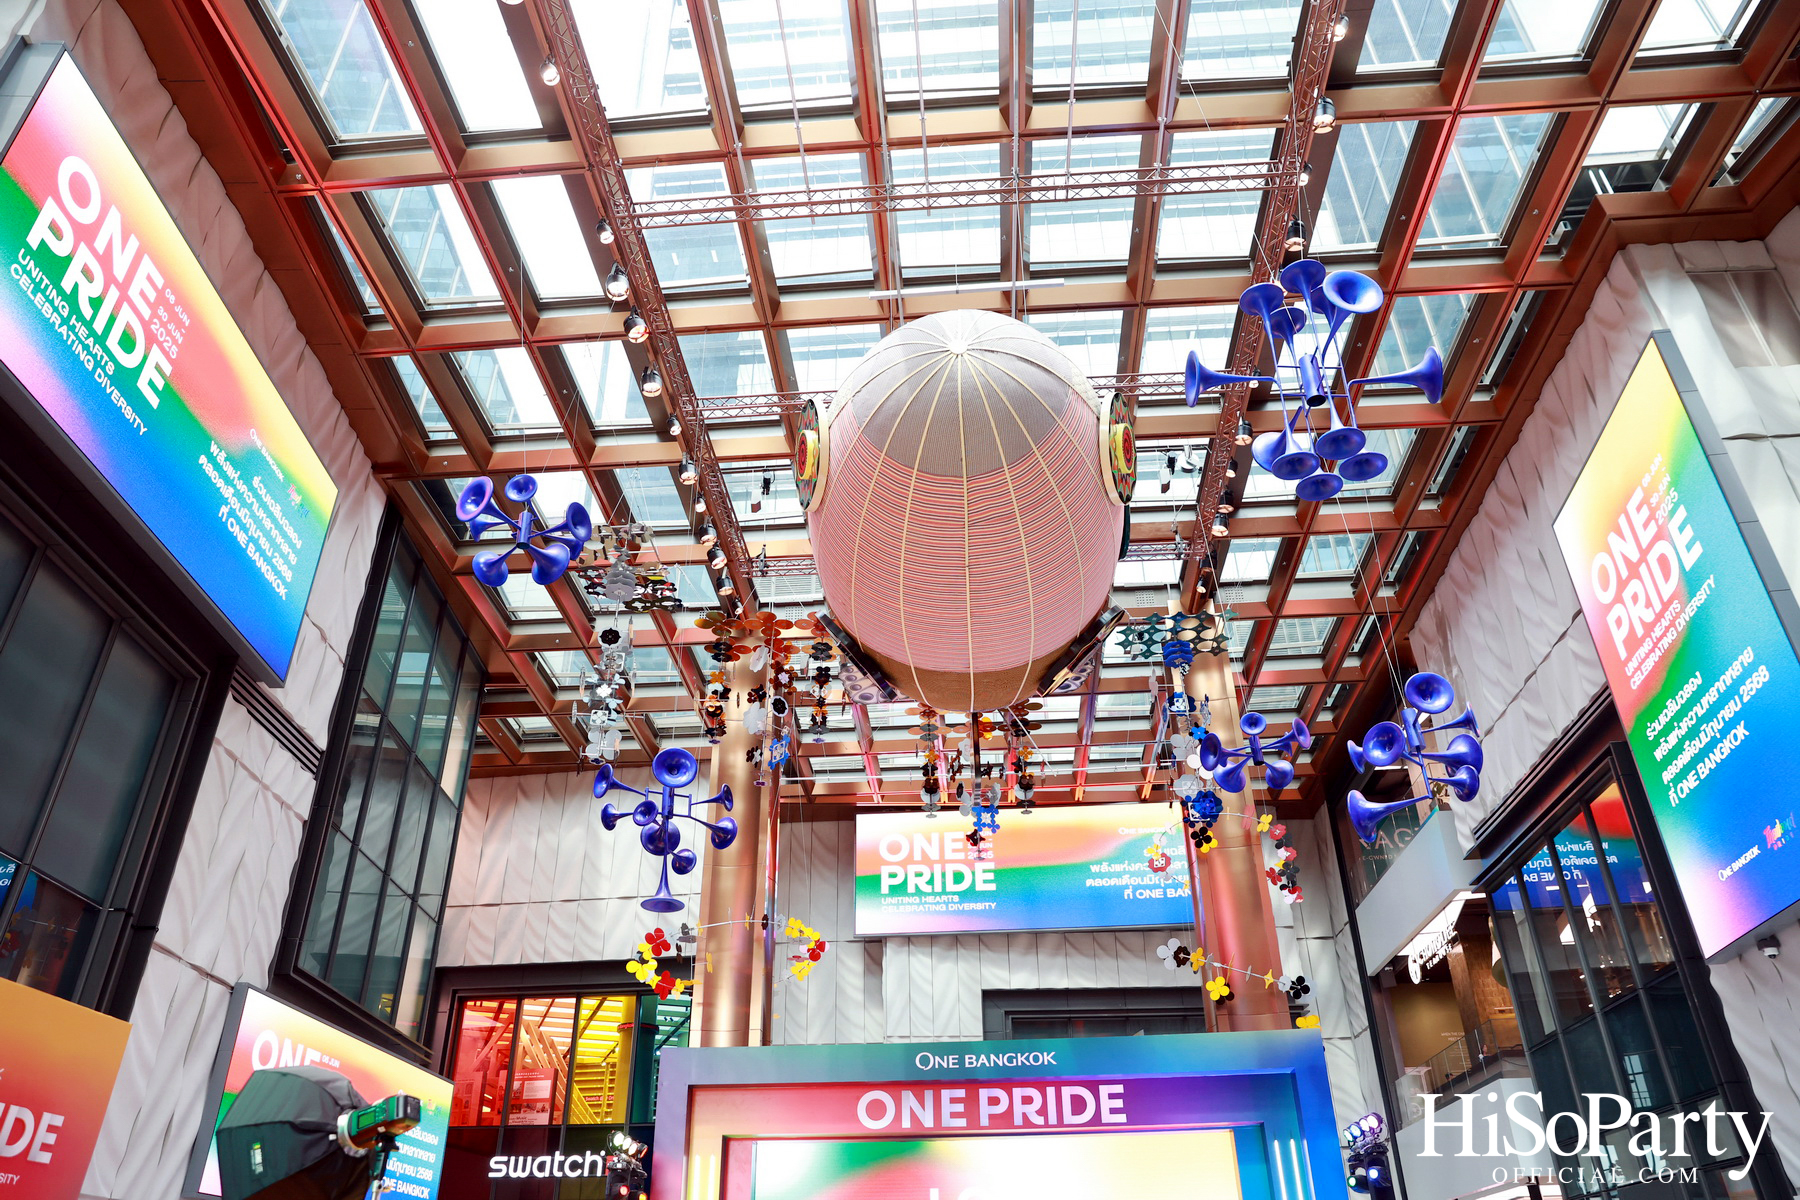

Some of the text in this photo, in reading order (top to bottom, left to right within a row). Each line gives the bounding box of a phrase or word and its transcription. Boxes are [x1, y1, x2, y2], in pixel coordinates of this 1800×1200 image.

[58, 155, 165, 321] ONE
[18, 248, 116, 375] UNITING HEARTS
[26, 196, 173, 410] PRIDE
[165, 288, 190, 327] 06 JUN
[150, 318, 177, 359] 2025
[157, 306, 184, 344] 30 JUN
[10, 263, 148, 436] CELEBRATING DIVERSITY
[1649, 453, 1663, 479] JUN
[1657, 473, 1671, 497] JUN
[210, 440, 297, 565] พลังแห่งความหลากหลาย
[1656, 487, 1679, 526] 2025
[227, 518, 249, 549] ONE
[247, 543, 288, 601] BANGKOK
[1591, 485, 1658, 605] ONE
[1606, 504, 1704, 662] PRIDE
[1624, 599, 1681, 677] UNITING HEARTS
[1630, 574, 1716, 691] CELEBRATING DIVERSITY
[1739, 665, 1770, 702] 2568
[1653, 646, 1754, 762] พลังแห่งความหลากหลาย
[1677, 769, 1700, 800] ONE
[1697, 720, 1750, 781] BANGKOK
[879, 831, 965, 862] ONE
[1730, 844, 1762, 875] BANGKOK
[880, 862, 997, 894] PRIDE
[1136, 888, 1164, 899] ONE
[881, 894, 959, 905] UNITING HEARTS
[881, 902, 997, 913] CELEBRATING DIVERSITY
[329, 1057, 340, 1068] JUN
[914, 1050, 1057, 1071] ONE BANGKOK
[856, 1084, 1128, 1130] ONE PRIDE
[415, 1166, 433, 1181] 2568
[488, 1150, 606, 1178] swatch
[396, 1180, 431, 1199] BANGKOK
